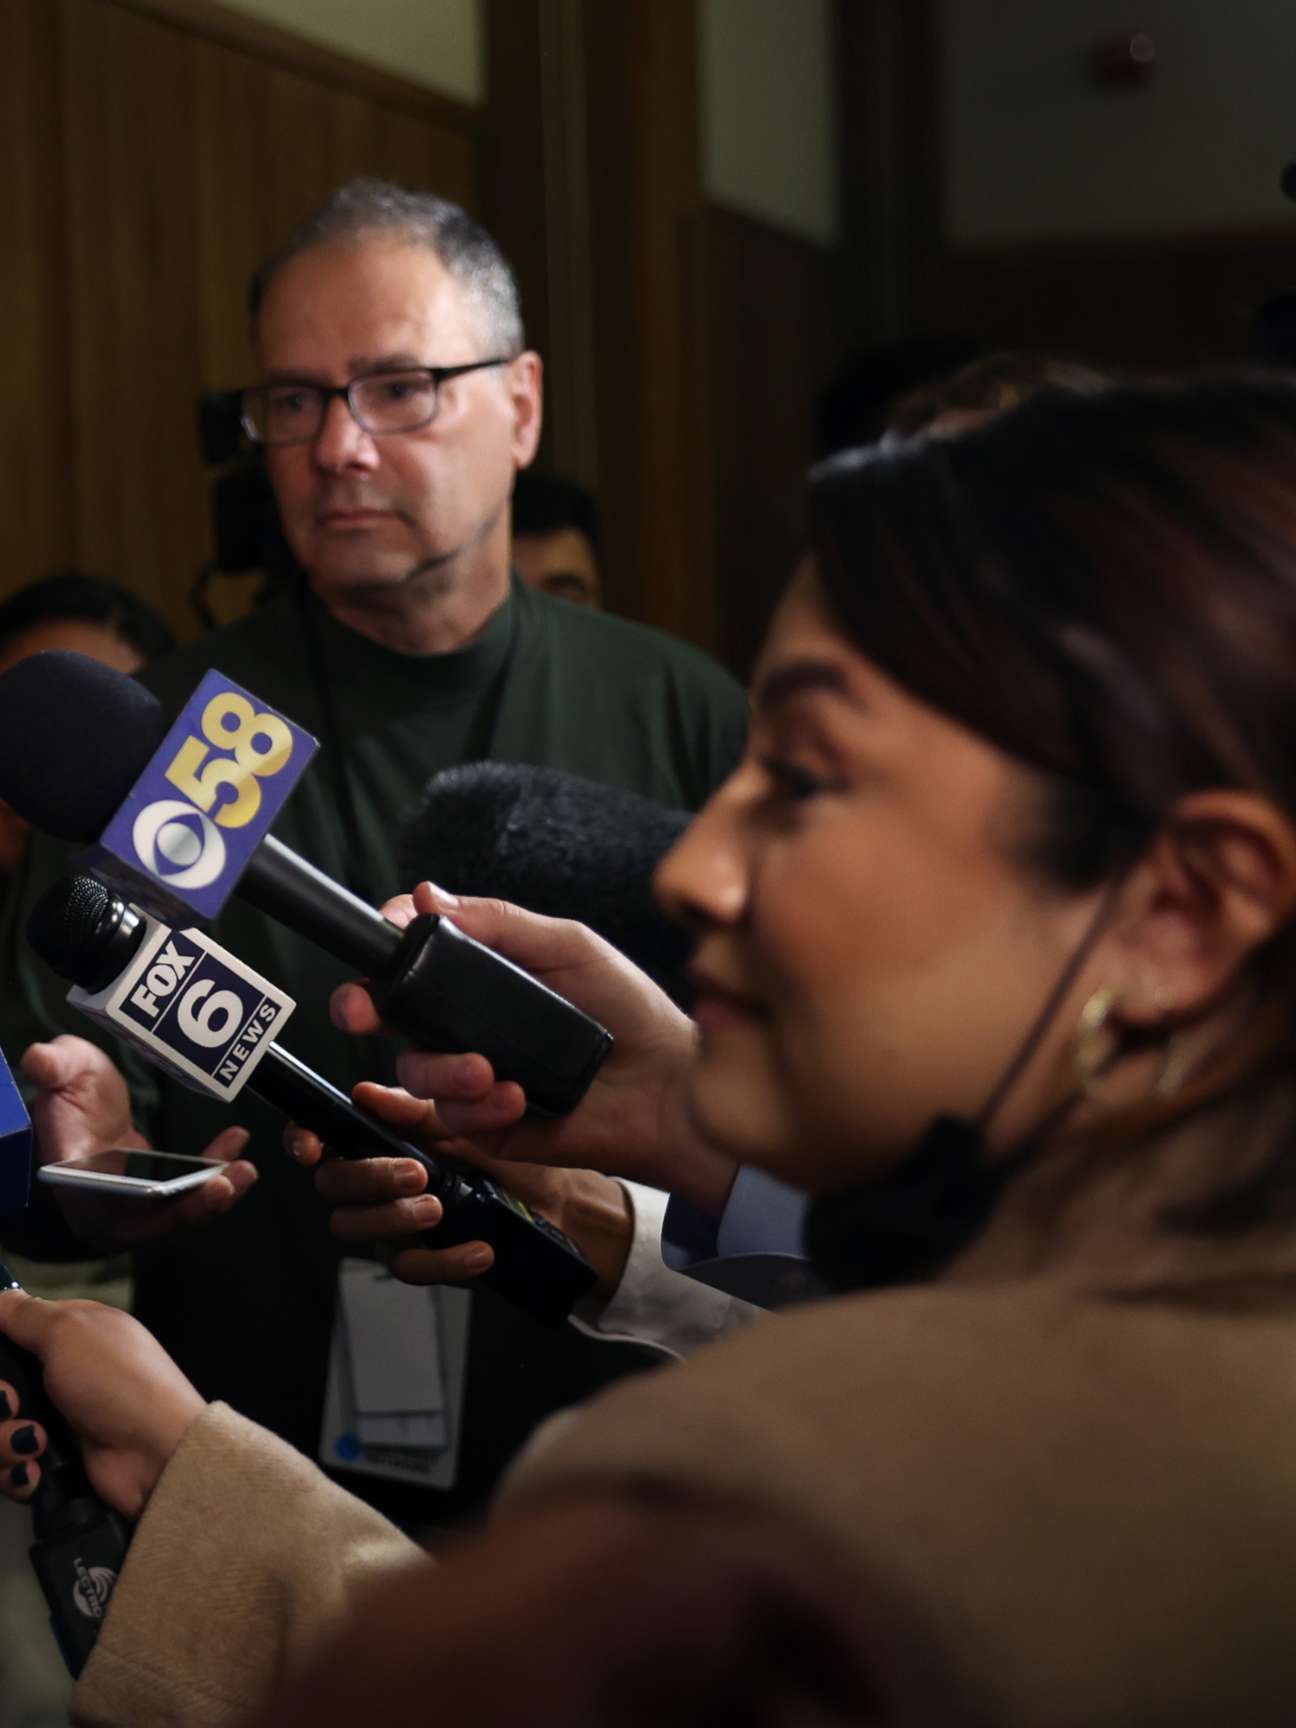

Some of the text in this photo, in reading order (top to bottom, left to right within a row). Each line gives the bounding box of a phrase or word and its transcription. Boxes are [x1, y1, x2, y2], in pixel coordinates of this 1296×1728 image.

[165, 692, 293, 828] 58
[130, 940, 195, 1018] FOX
[177, 979, 244, 1048] 6
[218, 1003, 276, 1080] NEWS
